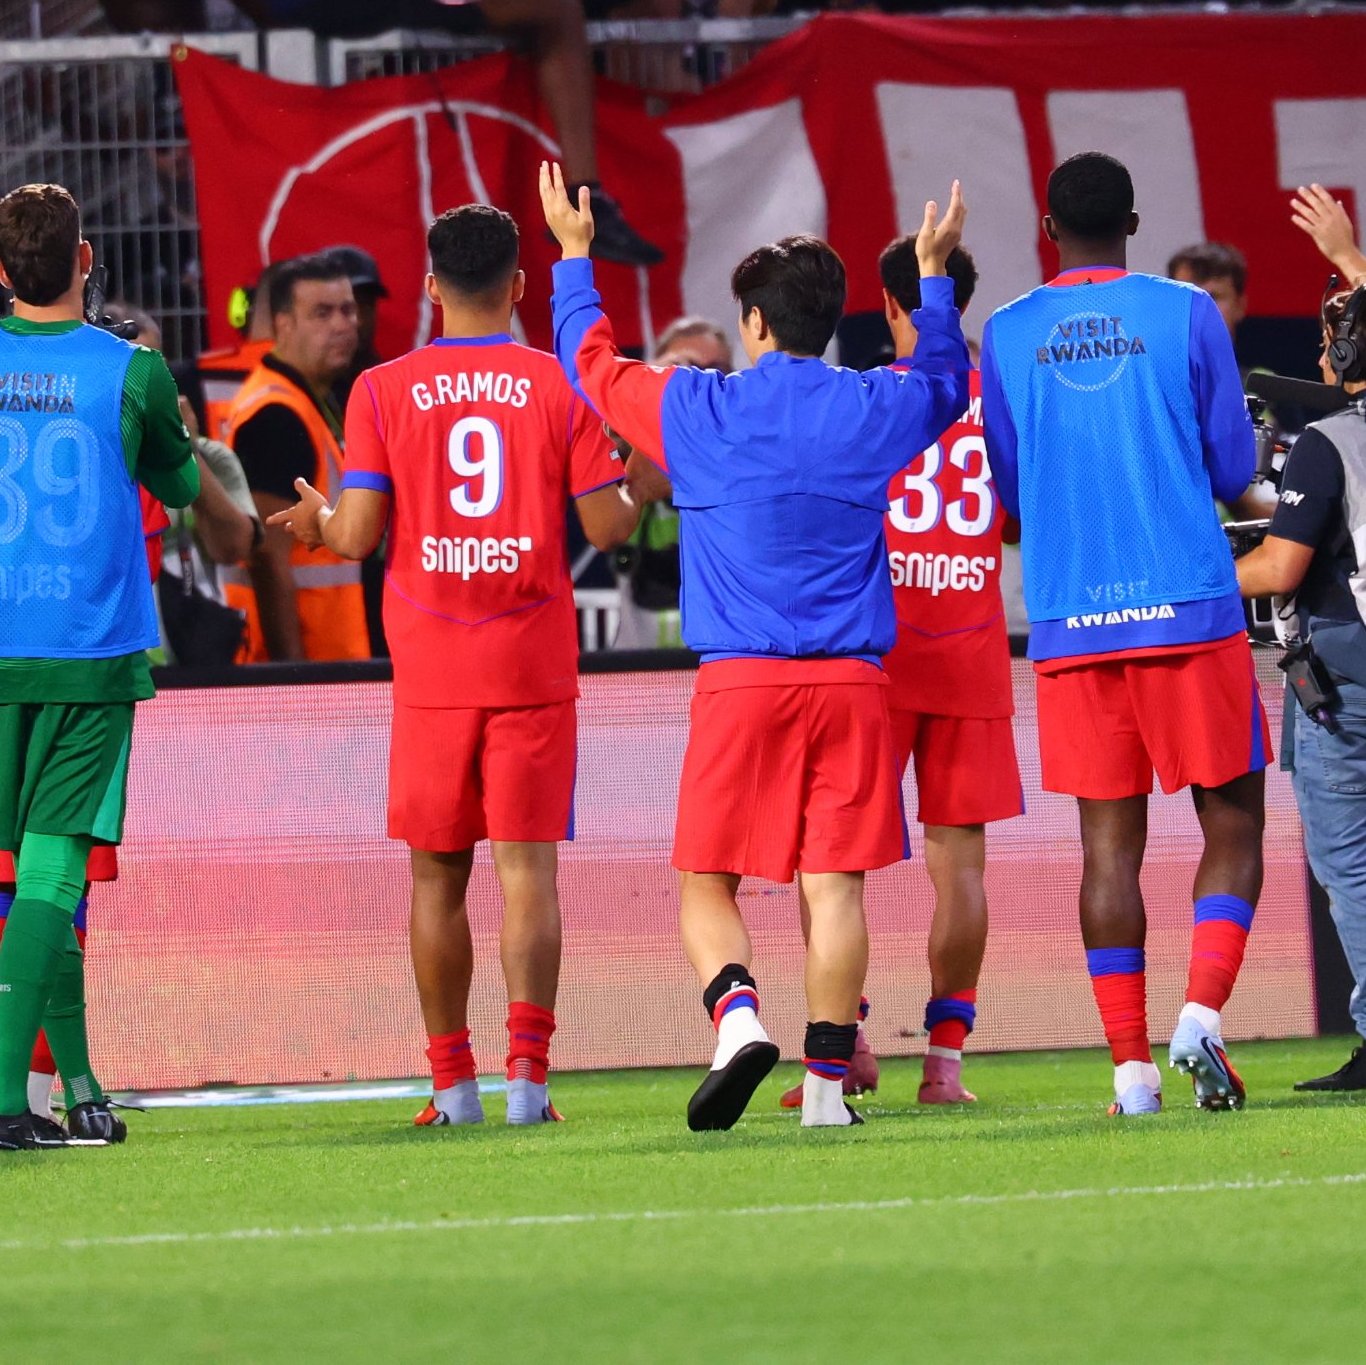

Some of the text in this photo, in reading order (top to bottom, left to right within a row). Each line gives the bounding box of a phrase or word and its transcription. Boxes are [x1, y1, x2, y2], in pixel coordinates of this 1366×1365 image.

[1058, 317, 1123, 339] VISIT
[1037, 337, 1146, 366] RWANDA
[411, 370, 531, 413] G.RAMOS
[447, 416, 504, 518] 9
[888, 435, 995, 535] 33
[422, 535, 519, 580] snipes
[889, 552, 986, 596] snipes
[1086, 580, 1149, 604] VISIT
[1067, 601, 1176, 630] RWANDA
